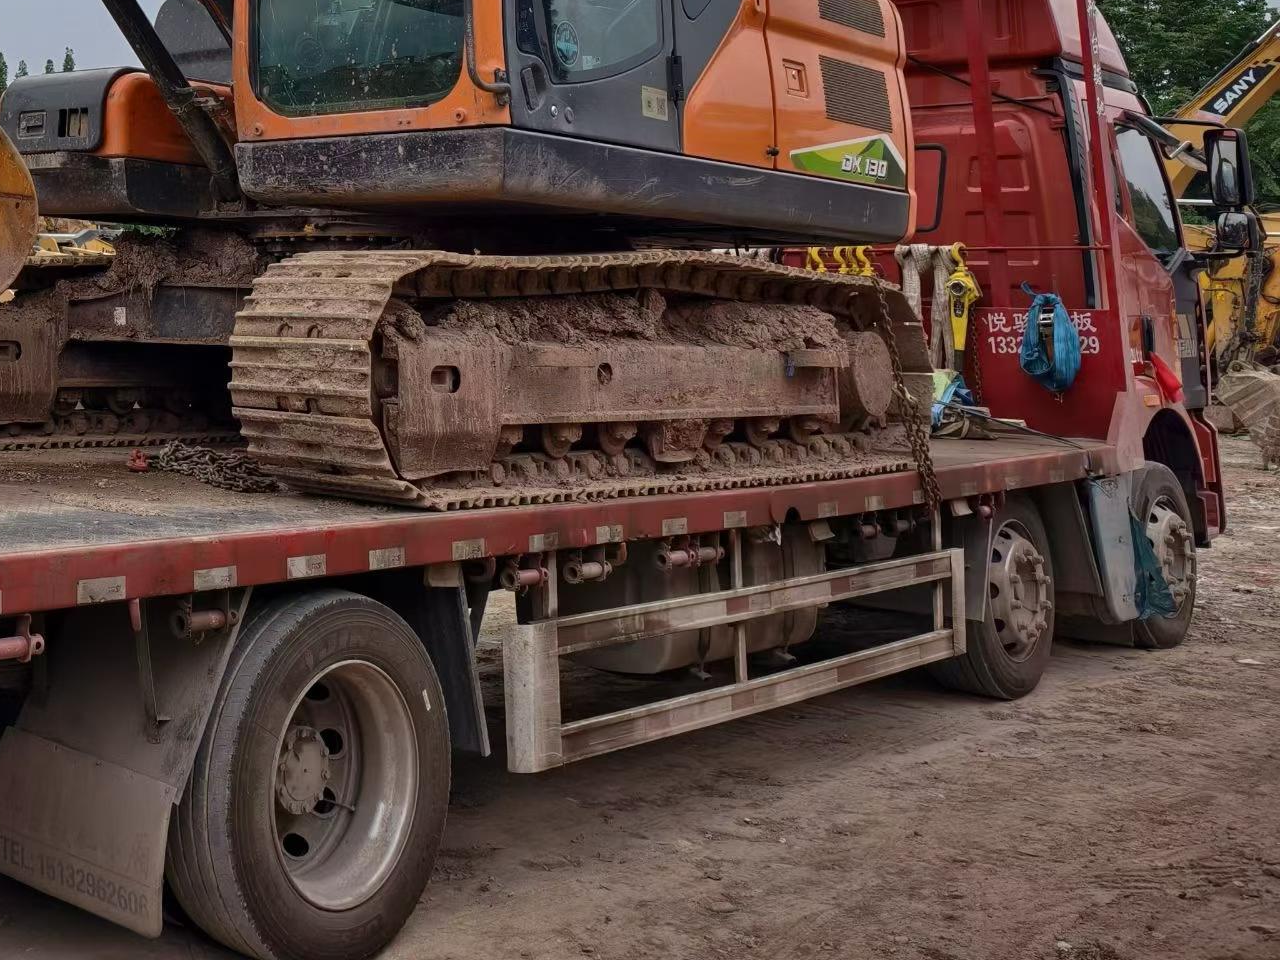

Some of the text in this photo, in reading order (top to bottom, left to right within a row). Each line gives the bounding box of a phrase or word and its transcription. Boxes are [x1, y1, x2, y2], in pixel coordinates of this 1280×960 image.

[1213, 69, 1257, 114] SANY
[865, 158, 888, 178] 130
[982, 311, 1098, 333] 悦骏板
